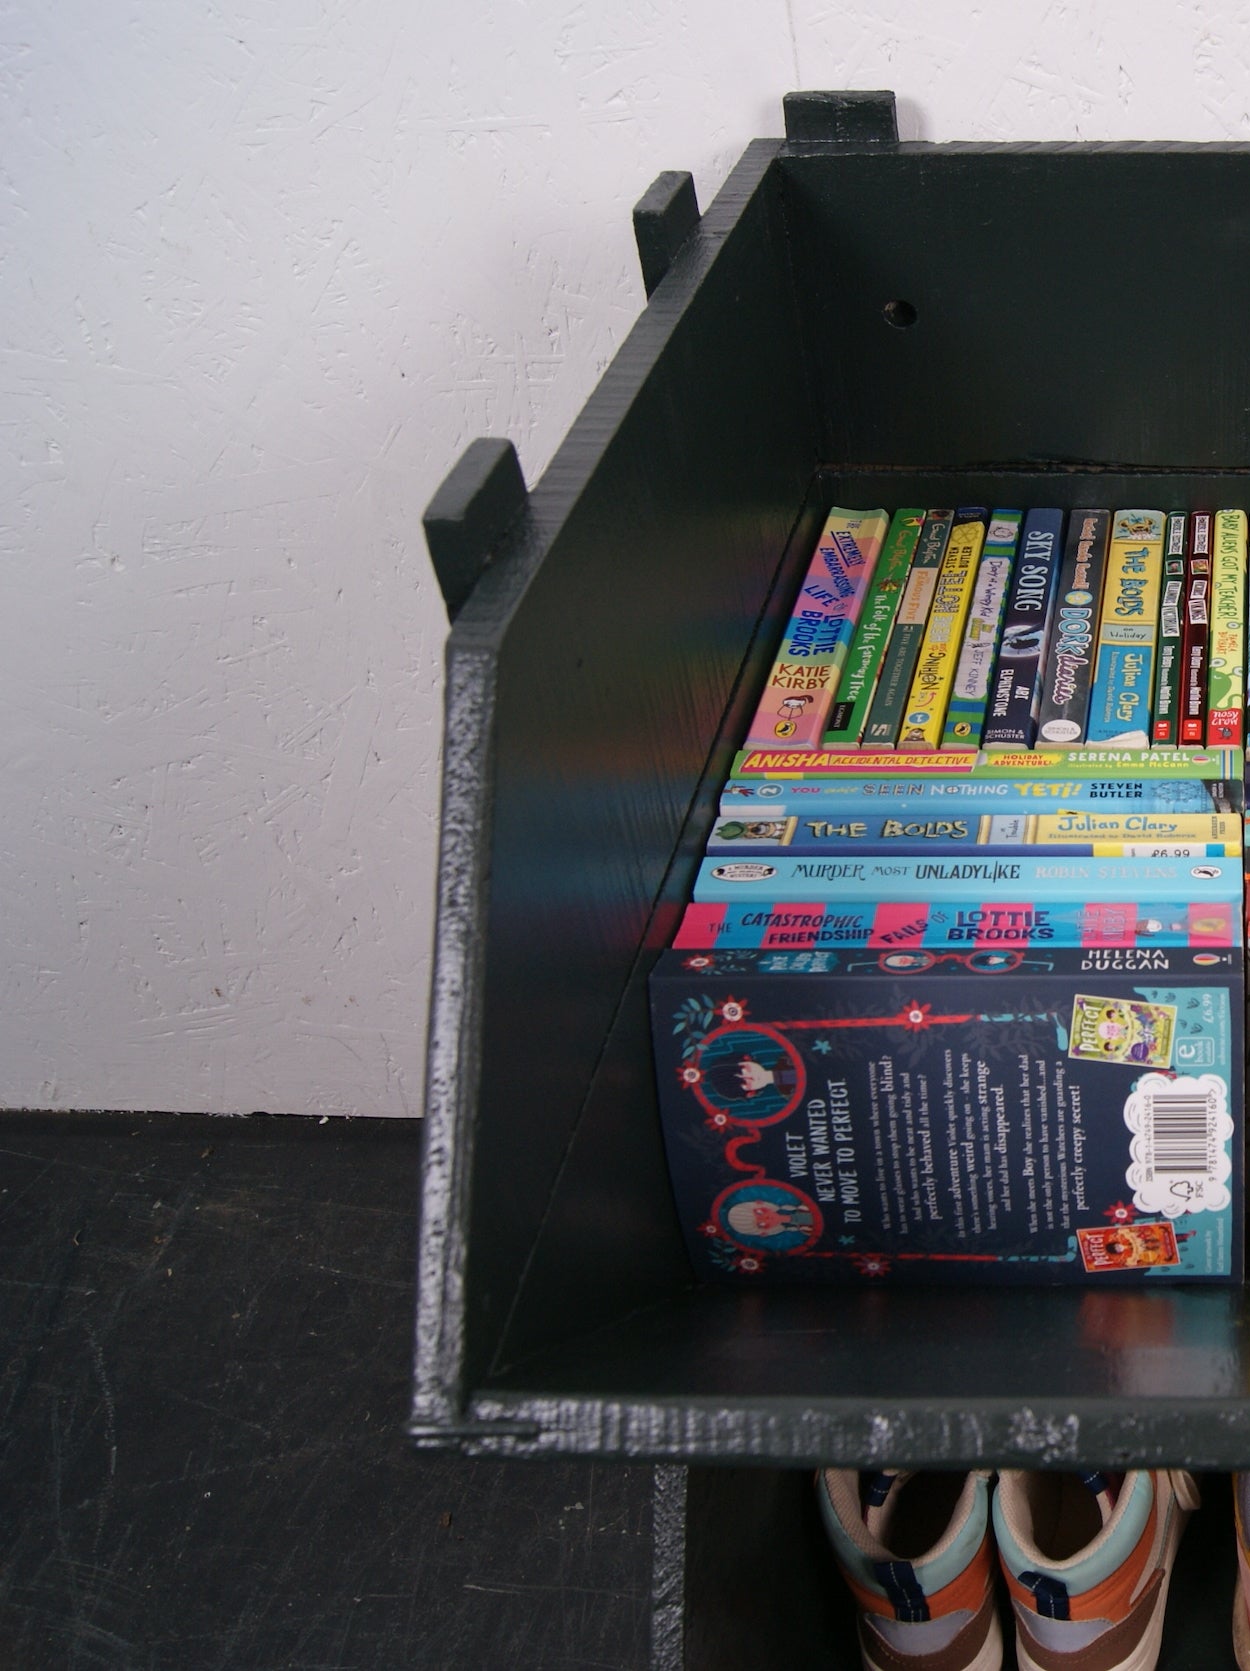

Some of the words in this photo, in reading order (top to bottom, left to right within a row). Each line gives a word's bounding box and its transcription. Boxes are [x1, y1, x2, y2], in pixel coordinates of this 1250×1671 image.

[1221, 514, 1240, 532] BABY
[836, 531, 865, 566] EXTREMELY
[1024, 530, 1054, 562] SKY
[1220, 533, 1239, 554] ALIENS
[819, 547, 855, 597] EMBARRASSING
[1122, 547, 1150, 574] THE
[1222, 556, 1238, 571] GOT
[804, 585, 839, 607] LIFE
[1013, 564, 1047, 611] SONG
[1115, 578, 1149, 617] BOLDS
[873, 605, 890, 622] Folk
[1217, 586, 1239, 620] TEACHER!
[788, 610, 823, 657] BROOKS
[813, 614, 845, 655] LOTTIE
[1056, 607, 1093, 655] DORK
[779, 664, 831, 677] KATIE
[851, 645, 875, 679] Faraway
[1121, 653, 1143, 687] Julian
[772, 675, 831, 689] KIRBY
[847, 680, 864, 701] Tree
[964, 668, 979, 697] KINNEY
[1052, 654, 1089, 704] diaries
[992, 669, 1015, 717] ELPHINSTONE
[1015, 685, 1030, 700] ABI
[1116, 692, 1140, 721] Clary
[1213, 711, 1239, 719] nosy
[1212, 717, 1239, 726] crow
[831, 756, 902, 765] ACCIDENTAL
[905, 756, 970, 765] DETECTIVE
[1068, 752, 1132, 762] SERENA
[1141, 752, 1189, 762] PATEL
[863, 784, 925, 796] SEEN
[930, 784, 1008, 797] NOTHING
[1090, 782, 1143, 790] STEVEN
[1090, 790, 1143, 798] BUTLER
[806, 820, 867, 838] THE
[882, 819, 968, 838] BOLDS
[1057, 815, 1119, 832] Julian
[1125, 816, 1178, 834] Clary
[1152, 849, 1190, 857] £6.99
[791, 864, 865, 881] MURDER
[871, 866, 911, 876] MOST
[915, 861, 1021, 883] UNLADYLIKE
[1035, 866, 1089, 878] ROBIN
[1099, 866, 1178, 878] STEVENS
[708, 922, 733, 933] THE
[741, 912, 864, 928] CATASTROPHIC
[956, 911, 1050, 927] LOTTIE
[768, 928, 874, 944] FRIENDSHIP
[880, 919, 929, 944] FAILS
[947, 928, 1054, 940] BROOKS
[1080, 959, 1169, 970] DUGGAN
[1089, 949, 1165, 959] HELENA
[1079, 1003, 1101, 1052] PERFECT
[879, 1055, 896, 1092] blind?
[976, 1060, 991, 1105] strange
[829, 1078, 853, 1142] PERFECT.
[1068, 1085, 1081, 1124] secret!
[809, 1098, 830, 1156] WANTED
[788, 1131, 808, 1178] VIOLET
[838, 1148, 855, 1164] TO
[918, 1130, 934, 1174] behaved
[961, 1141, 976, 1172] weird
[1072, 1127, 1086, 1163] creepy
[948, 1148, 962, 1200] adventure
[1022, 1157, 1036, 1176] Boy
[815, 1161, 836, 1202] NEVER
[840, 1170, 860, 1205] MOVE
[1070, 1166, 1090, 1211] perfectly
[845, 1209, 862, 1223] TO
